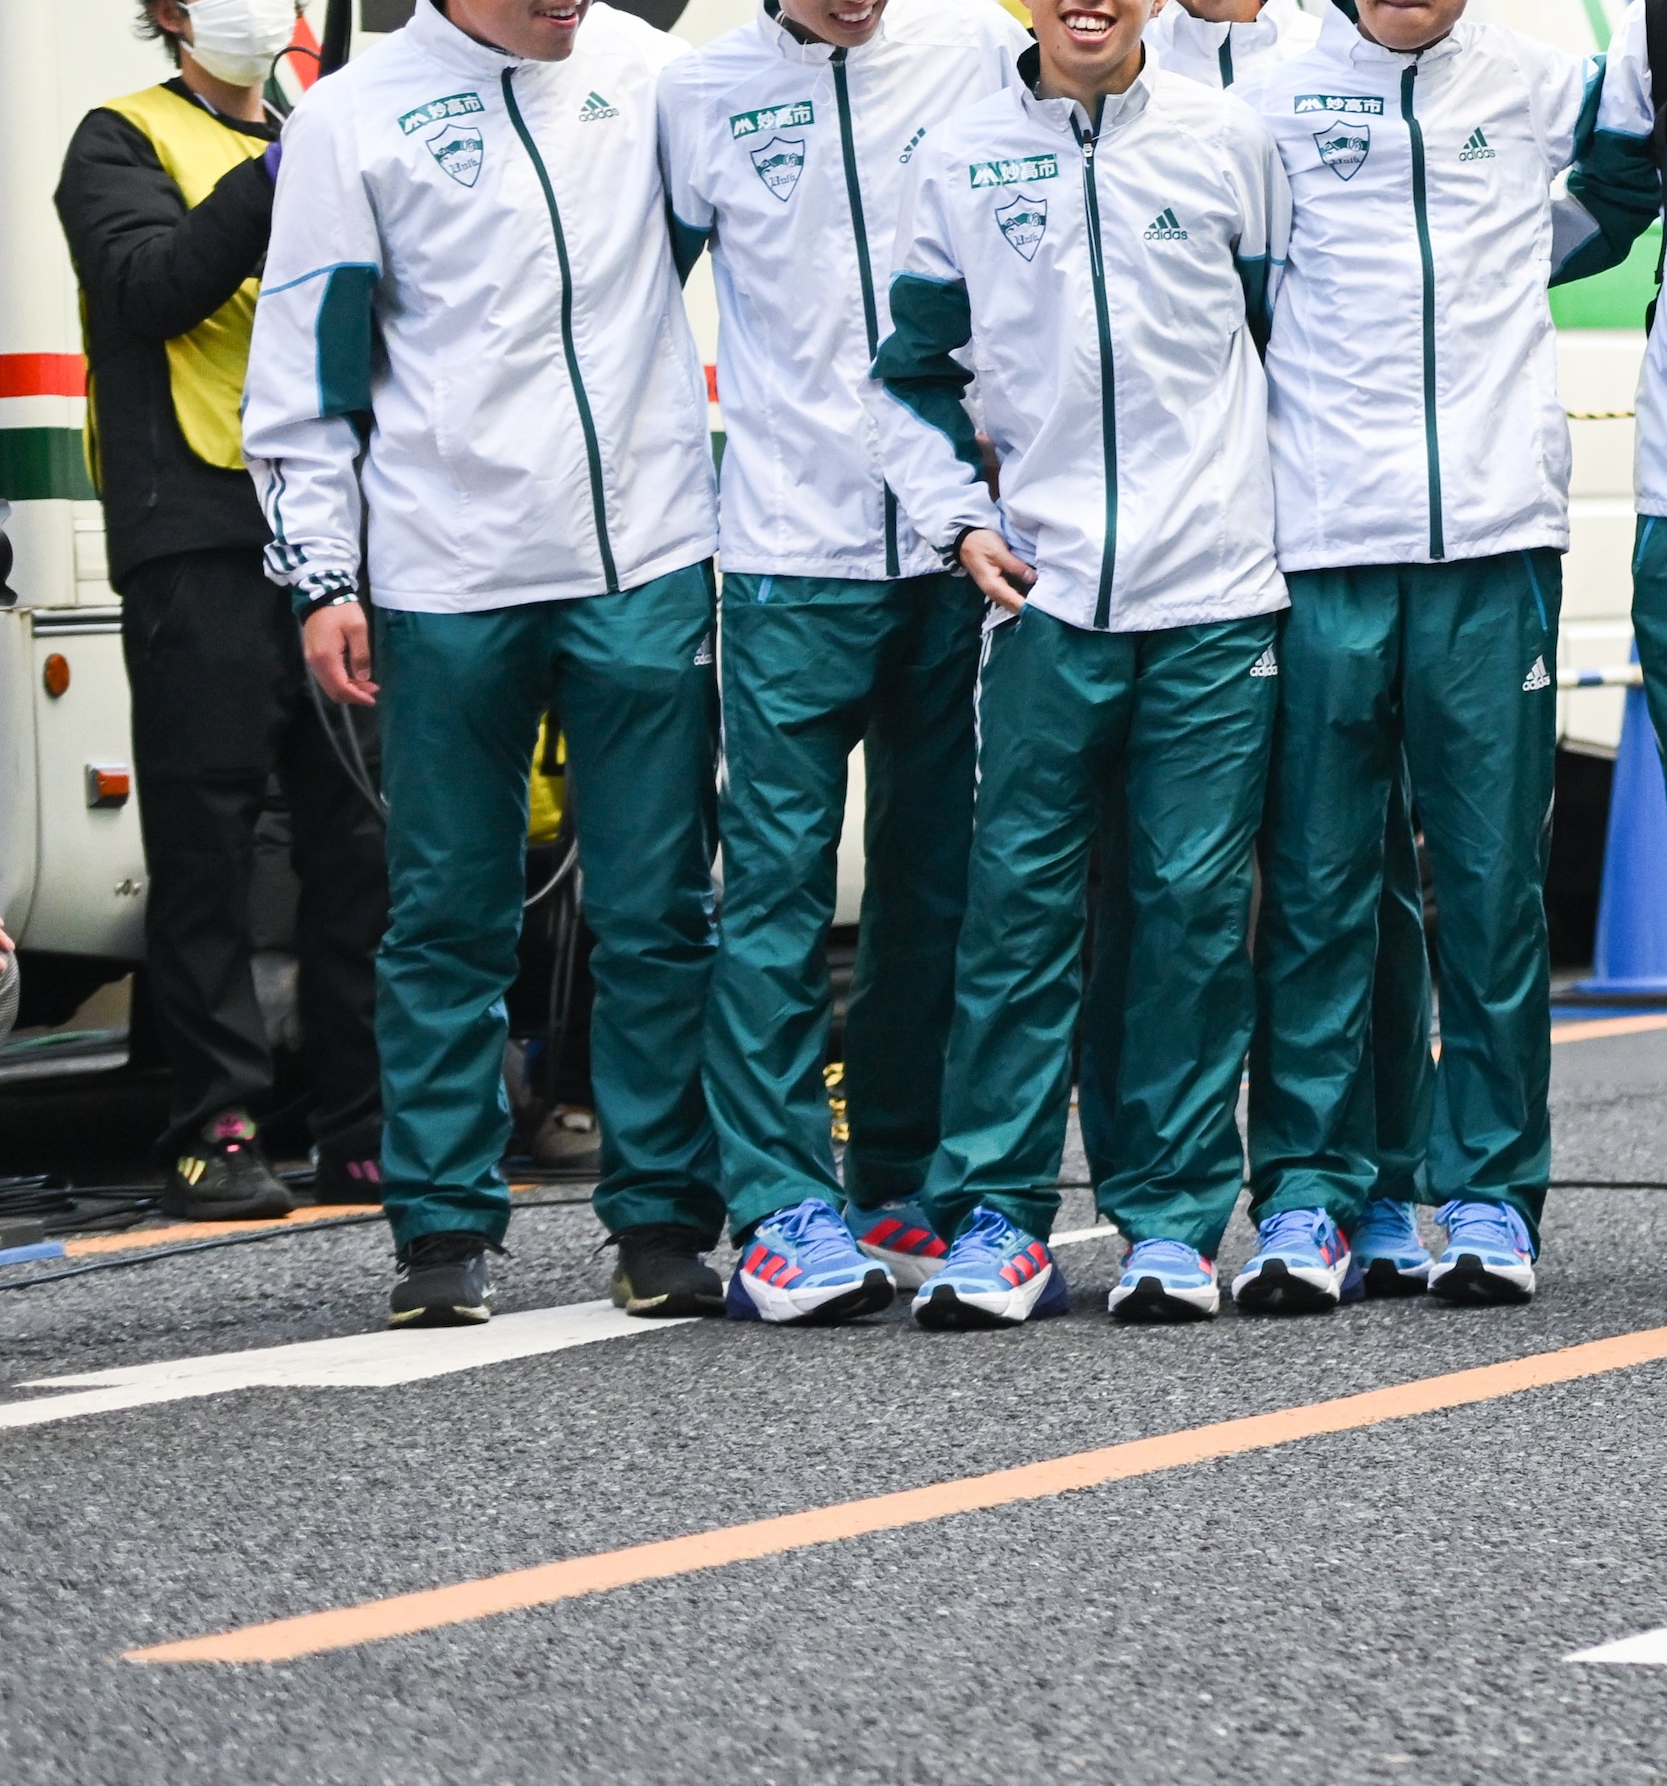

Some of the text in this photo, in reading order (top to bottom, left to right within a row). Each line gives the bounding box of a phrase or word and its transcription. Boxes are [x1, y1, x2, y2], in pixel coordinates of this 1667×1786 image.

[427, 95, 482, 120] 妙高市
[578, 106, 620, 122] adidas
[1325, 97, 1382, 114] 妙高市
[757, 105, 811, 130] 妙高市
[1459, 147, 1496, 162] adidas
[1001, 158, 1056, 182] 妙高市
[1143, 228, 1188, 241] adidas
